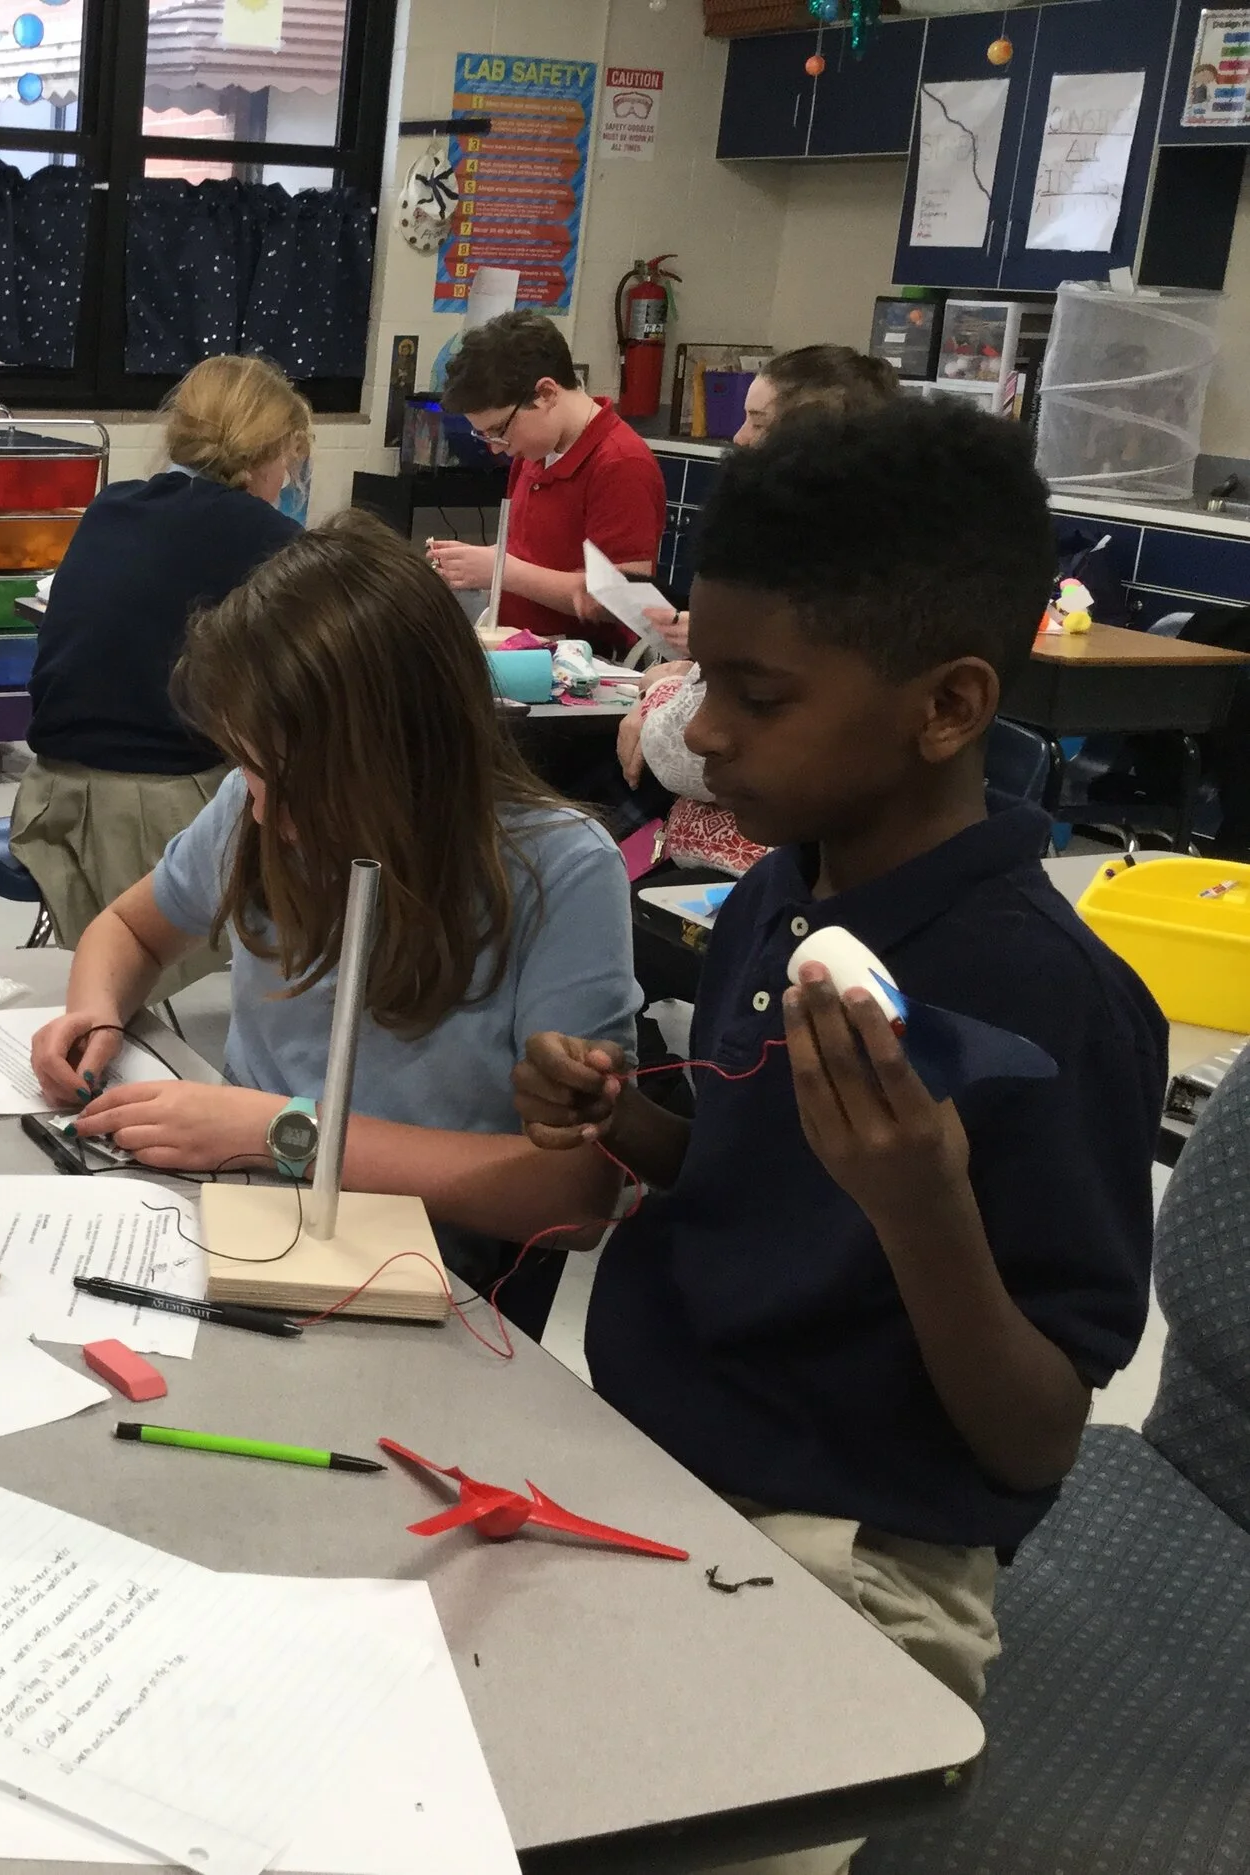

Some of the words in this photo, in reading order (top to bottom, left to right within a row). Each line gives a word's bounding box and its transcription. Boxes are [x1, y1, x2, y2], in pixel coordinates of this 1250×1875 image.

[464, 59, 505, 81] LAB
[513, 62, 589, 87] SAFETY
[611, 71, 659, 88] CAUTION
[606, 123, 626, 131] SAFETY
[472, 140, 478, 149] 3
[469, 161, 475, 170] 4
[468, 183, 473, 192] 5
[465, 203, 471, 213] 6
[463, 224, 469, 234] 7
[461, 245, 467, 255] 8
[459, 265, 465, 275] 9
[455, 286, 464, 295] 10
[150, 1298, 211, 1319] Invenergy
